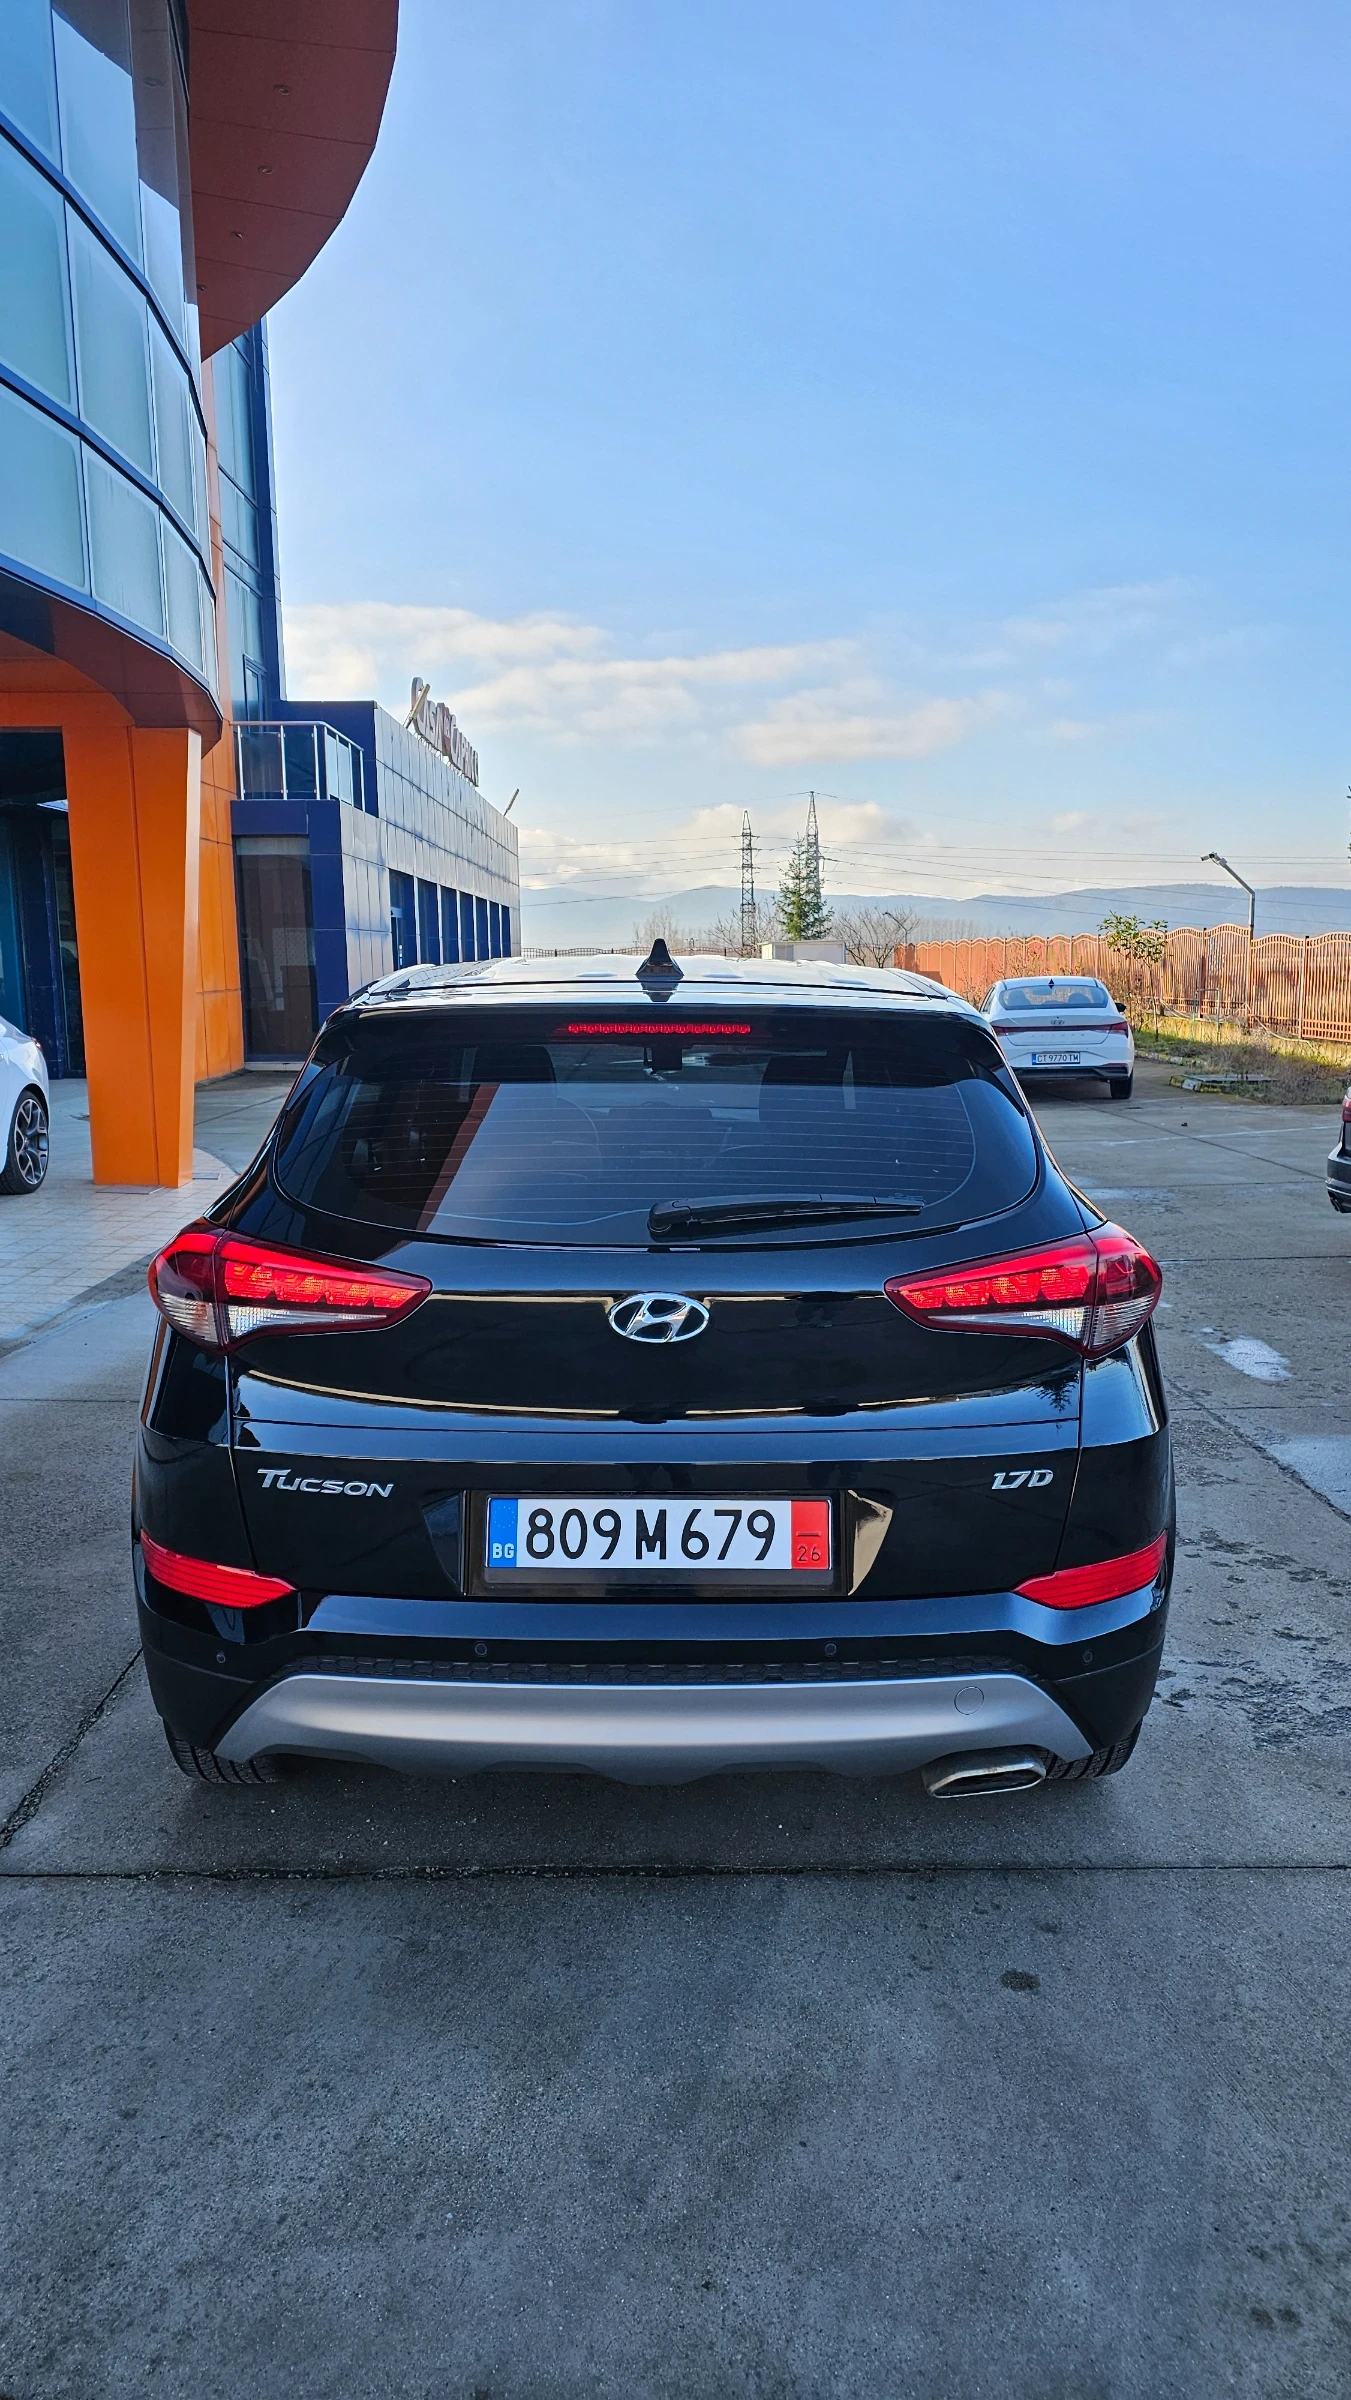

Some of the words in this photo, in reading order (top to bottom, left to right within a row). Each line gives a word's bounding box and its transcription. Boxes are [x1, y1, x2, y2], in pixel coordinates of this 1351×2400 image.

[1037, 1054, 1047, 1063] CT
[1048, 1054, 1068, 1062] 9770
[492, 1543, 515, 1559] BG
[797, 1546, 821, 1562] 26
